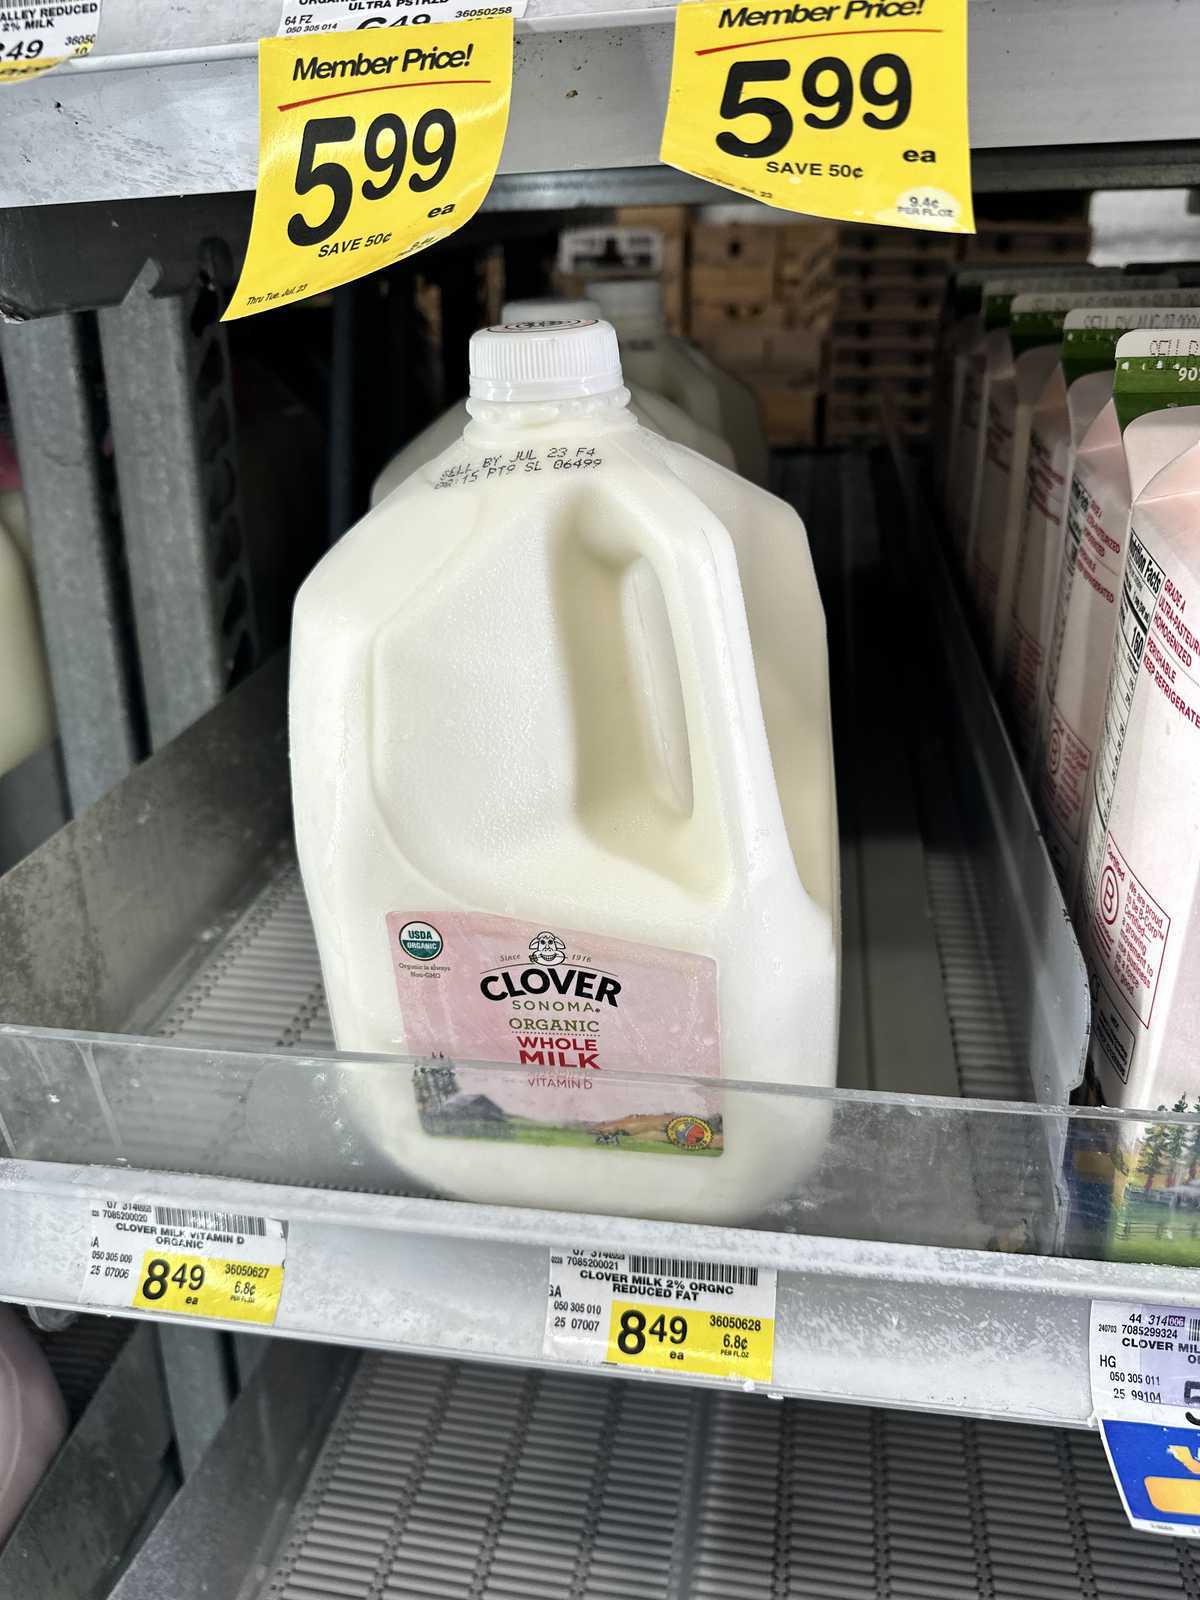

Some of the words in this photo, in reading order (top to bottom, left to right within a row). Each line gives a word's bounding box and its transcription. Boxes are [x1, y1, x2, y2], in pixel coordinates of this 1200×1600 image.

[40, 3, 98, 17] REDUCED
[348, 0, 392, 11] ULTRA
[455, 6, 513, 18] 36050258
[284, 16, 297, 26] 64
[299, 14, 313, 24] FZ
[718, 4, 841, 29] Member
[843, 0, 925, 20] Price!
[24, 18, 55, 30] MILK
[0, 39, 44, 60] 49
[293, 50, 399, 81] Member
[401, 43, 475, 72] Price!
[902, 149, 937, 163] ea
[766, 160, 823, 176] SAVE
[828, 164, 864, 179] 50¢
[427, 203, 457, 219] ea
[317, 238, 363, 259] SAVE
[364, 231, 393, 249] 50¢
[482, 455, 503, 469] BY
[510, 449, 537, 464] JUL
[546, 447, 569, 459] 23
[576, 447, 596, 458] F4
[524, 460, 543, 473] SL
[1144, 559, 1161, 594] Facts
[1164, 578, 1182, 607] GRADE
[1179, 599, 1186, 614] A
[1158, 594, 1200, 656] ULTRA-PASTEUR
[1153, 611, 1192, 668] HOMOGENIZED
[1142, 655, 1156, 675] KEEP
[1147, 636, 1177, 684] PERISHABLE
[1145, 904, 1163, 929] proud
[407, 930, 433, 940] USDA
[1125, 923, 1147, 956] growing
[406, 941, 438, 951] ORGANIC
[1120, 928, 1147, 969] movement
[500, 953, 521, 963] Since
[571, 952, 593, 964] 1916
[480, 967, 622, 1008] CLOVER
[508, 1017, 601, 1033] ORGANIC
[516, 1035, 598, 1052] WHOLE
[519, 1050, 603, 1071] MILK
[528, 1077, 581, 1090] VITAMIN
[583, 1079, 594, 1091] D
[116, 1222, 158, 1236] CLOVER
[160, 1227, 186, 1238] MILK
[190, 1231, 234, 1244] VITAMIN
[236, 1236, 245, 1246] D
[155, 1236, 205, 1250] ORGANIC
[91, 1250, 105, 1260] 050
[105, 1252, 119, 1262] 305
[567, 1256, 619, 1271] 7085200021
[90, 1265, 101, 1276] 25
[104, 1267, 130, 1280] 07006
[224, 1264, 271, 1279] 36050627
[234, 1281, 256, 1296] 6.8¢
[579, 1269, 629, 1284] CLOVER
[631, 1275, 662, 1288] MILK
[666, 1279, 686, 1290] 2%
[689, 1282, 735, 1296] ORGNC
[185, 1296, 199, 1305] ea
[612, 1283, 673, 1299] REDUCED
[675, 1290, 700, 1302] FAT
[553, 1301, 569, 1311] 050
[570, 1302, 586, 1313] 305
[586, 1304, 602, 1315] 010
[554, 1316, 566, 1328] 25
[571, 1318, 600, 1332] 07007
[709, 1314, 762, 1332] 36050628
[1129, 1313, 1142, 1324] 44
[1121, 1324, 1178, 1339] 7085299324
[723, 1334, 748, 1351] 6.8¢
[1121, 1337, 1174, 1352] CLOVER
[1177, 1342, 1200, 1354] MIL
[669, 1350, 685, 1361] ea
[1099, 1354, 1117, 1369] HG
[1109, 1371, 1126, 1383] 050
[1127, 1373, 1143, 1384] 305
[1145, 1375, 1161, 1386] 011
[1113, 1387, 1126, 1400] 25
[1131, 1389, 1161, 1403] 99104
